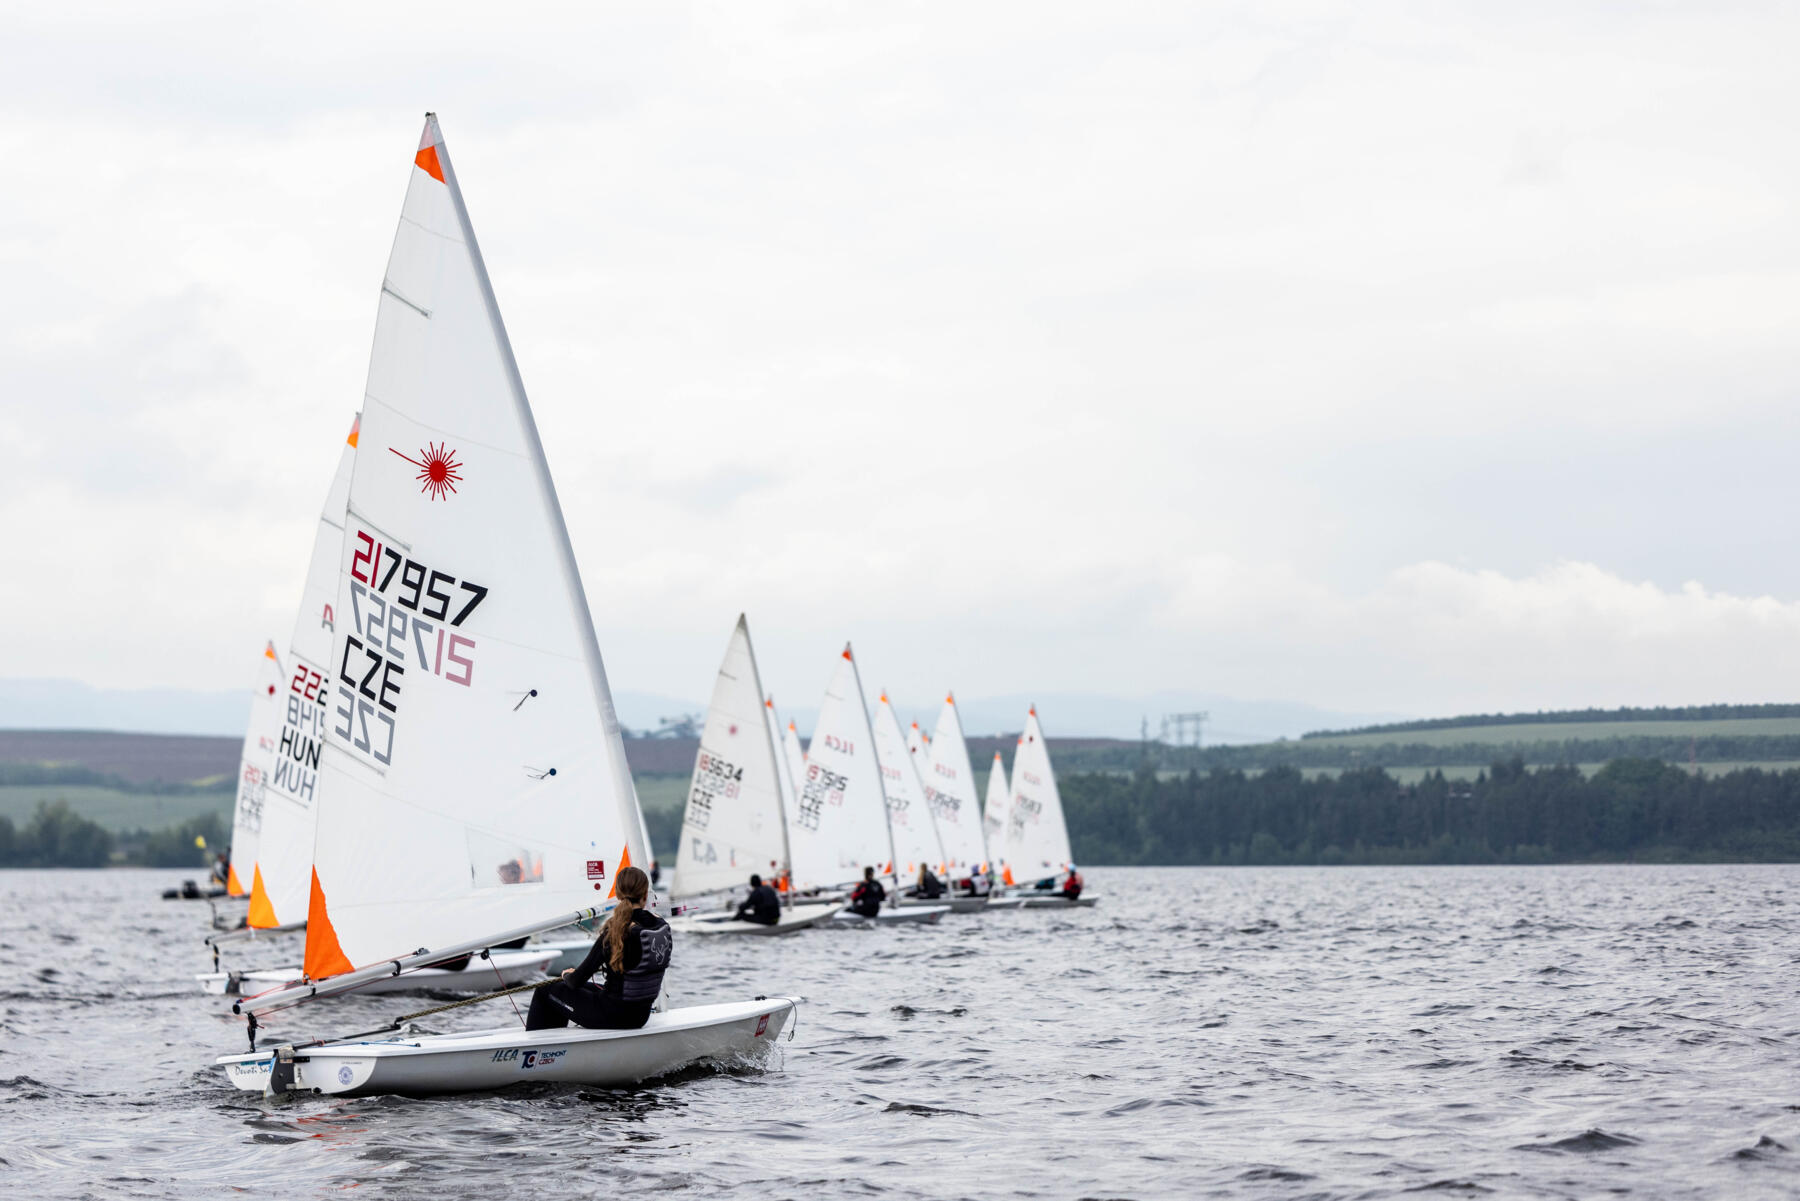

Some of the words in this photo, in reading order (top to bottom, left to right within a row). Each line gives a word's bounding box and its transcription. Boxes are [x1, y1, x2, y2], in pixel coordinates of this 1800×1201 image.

[351, 530, 488, 627] 217957
[291, 664, 329, 707] 222
[340, 635, 404, 713] CZE
[280, 725, 322, 770] HUN
[491, 1049, 519, 1062] ILCA
